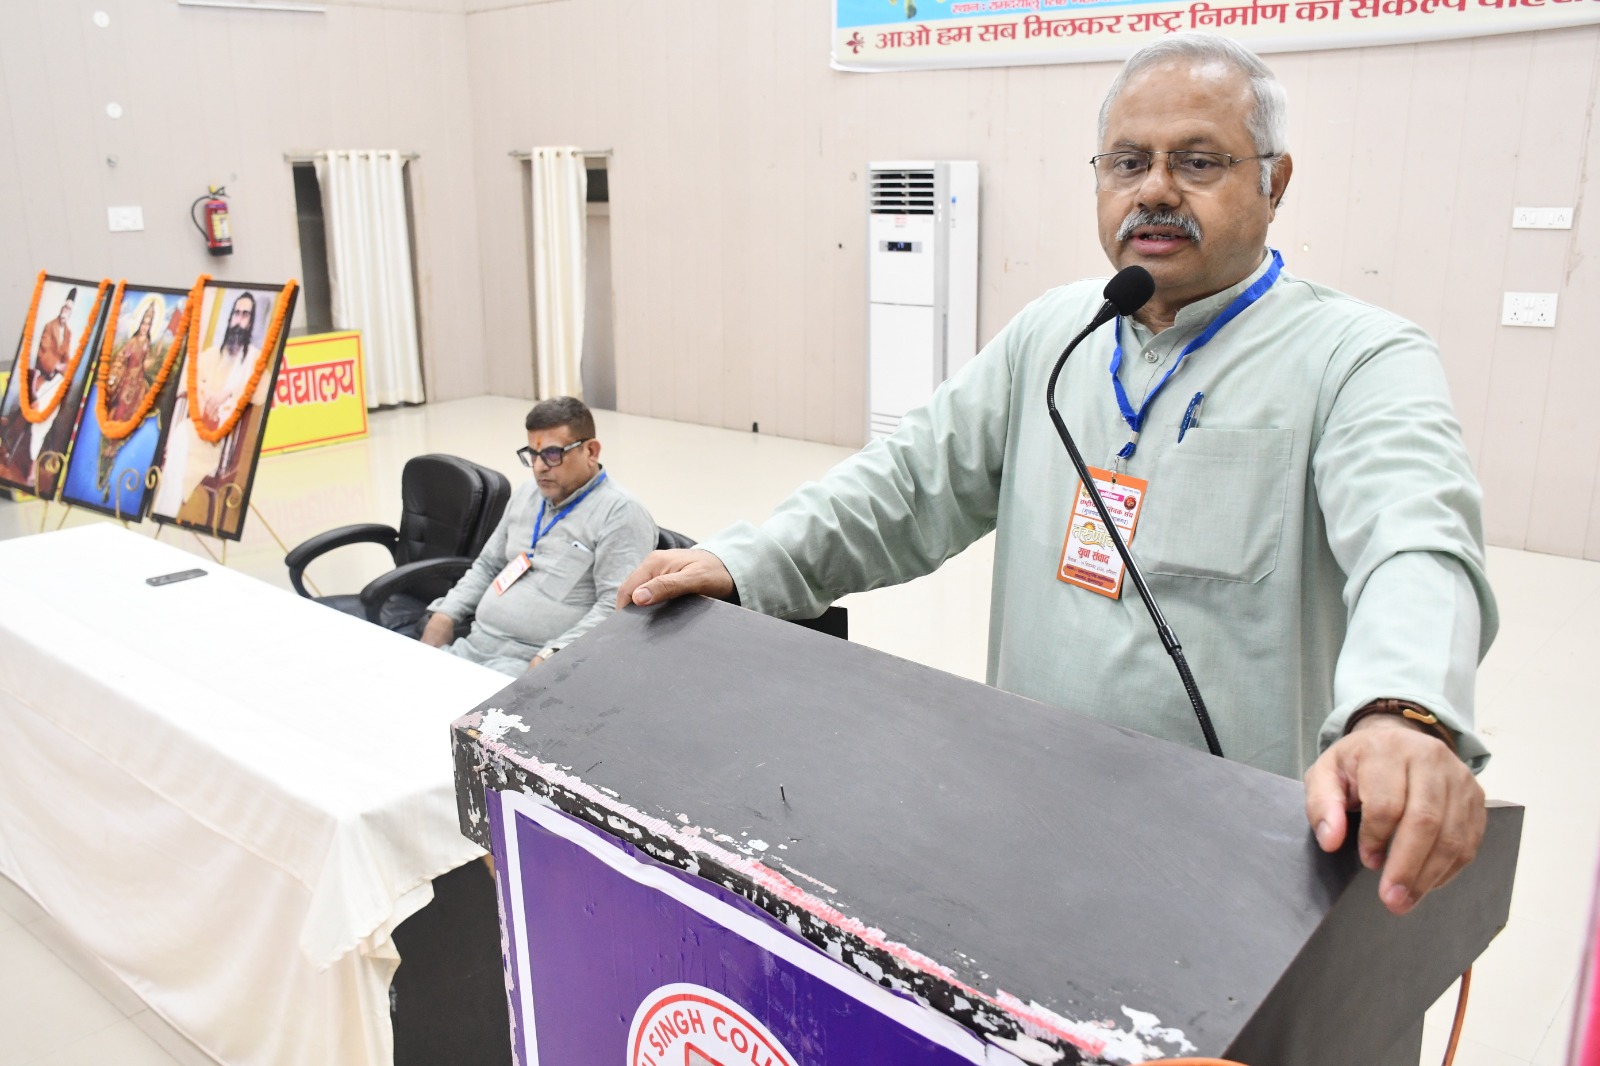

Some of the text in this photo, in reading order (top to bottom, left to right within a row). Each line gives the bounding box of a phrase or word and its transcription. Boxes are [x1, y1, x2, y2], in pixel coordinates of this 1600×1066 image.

[875, 24, 931, 49] आओ
[936, 25, 973, 46] हम
[978, 22, 1017, 42] सब
[1023, 14, 1122, 40] मिलकर
[1128, 10, 1184, 34] राष्ट्र
[1189, 0, 1289, 29] निर्माण
[648, 1008, 706, 1057] SINGH
